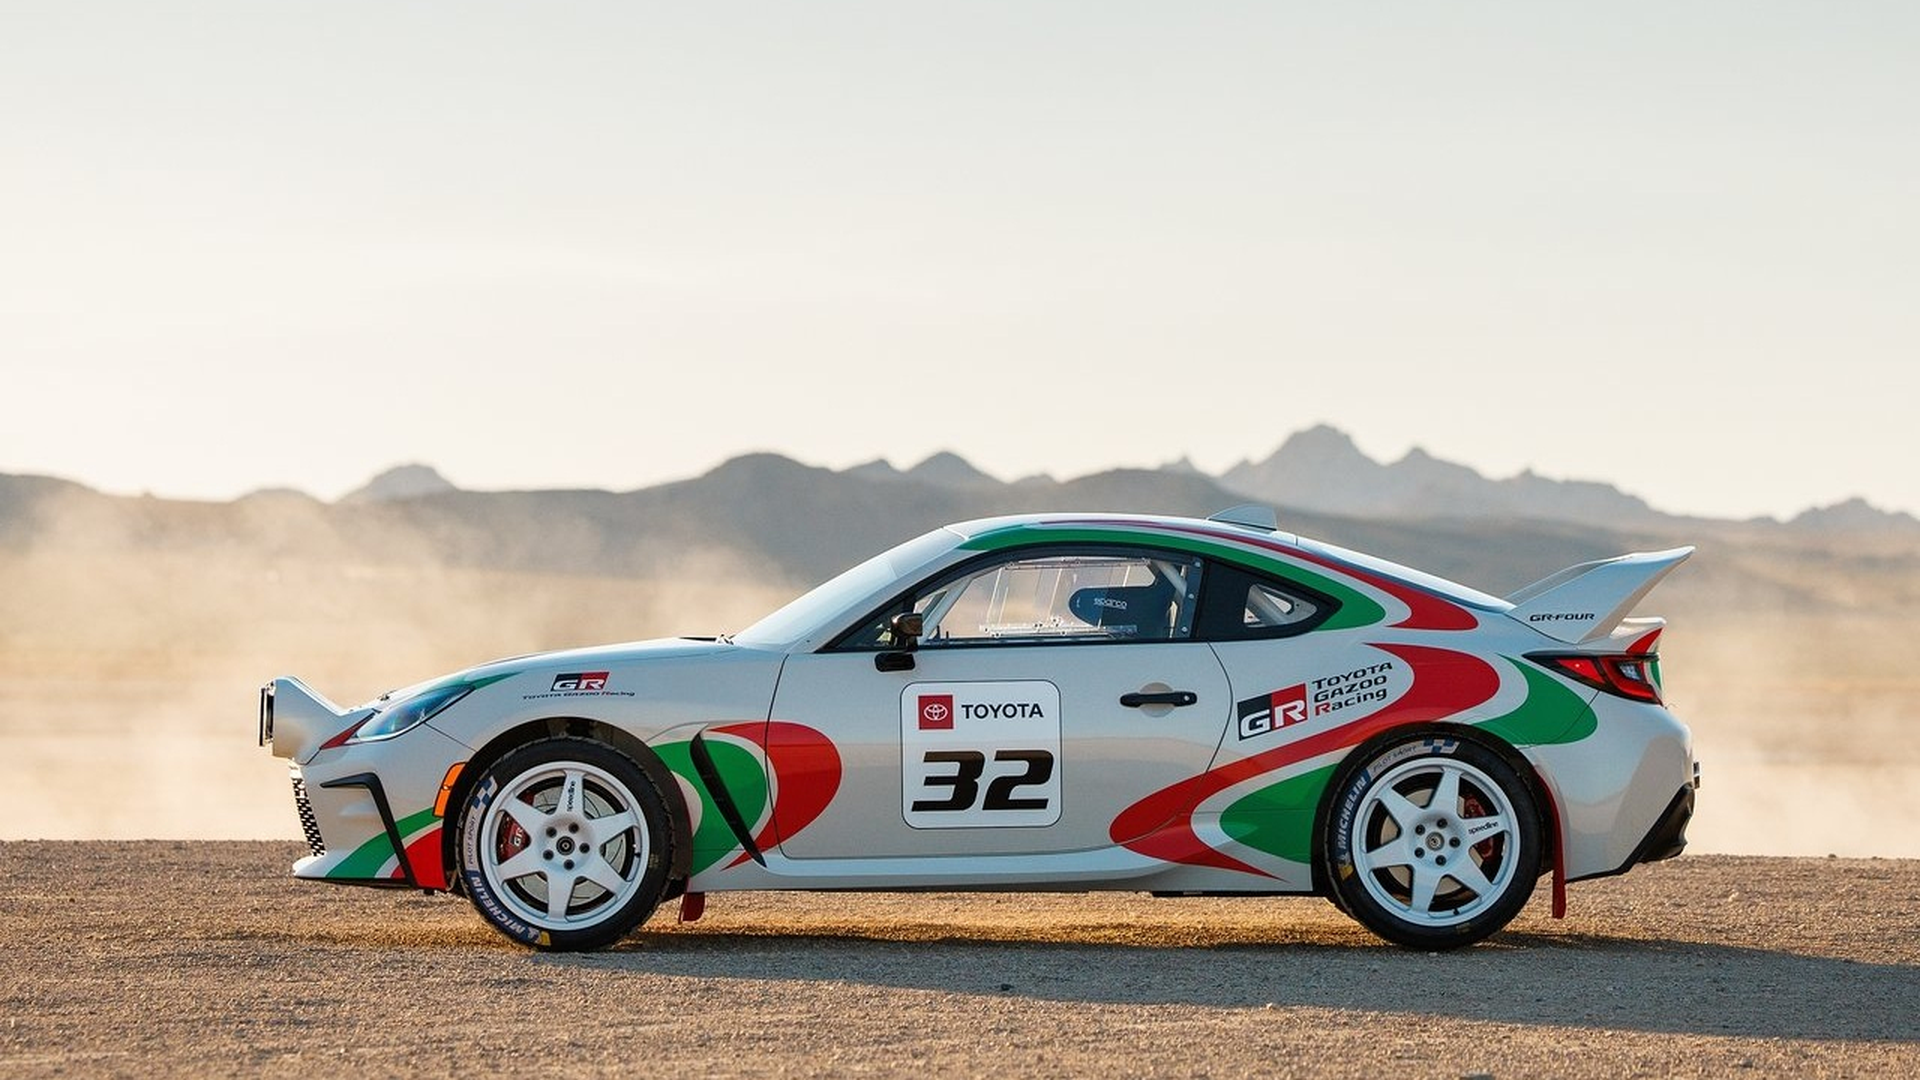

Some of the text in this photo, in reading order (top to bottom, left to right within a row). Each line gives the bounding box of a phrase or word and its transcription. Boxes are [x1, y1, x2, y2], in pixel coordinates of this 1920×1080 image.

[552, 678, 605, 691] GR
[1312, 662, 1393, 690] TOYOTA
[1314, 675, 1388, 703] GAZOO
[522, 692, 562, 700] TOYOTA
[1315, 688, 1388, 716] Racing
[961, 703, 1044, 719] TOYOTA
[1240, 699, 1306, 738] GR
[911, 750, 1054, 812] 32
[1337, 776, 1367, 850] MICHELIN
[471, 876, 525, 935] MICHELIN
